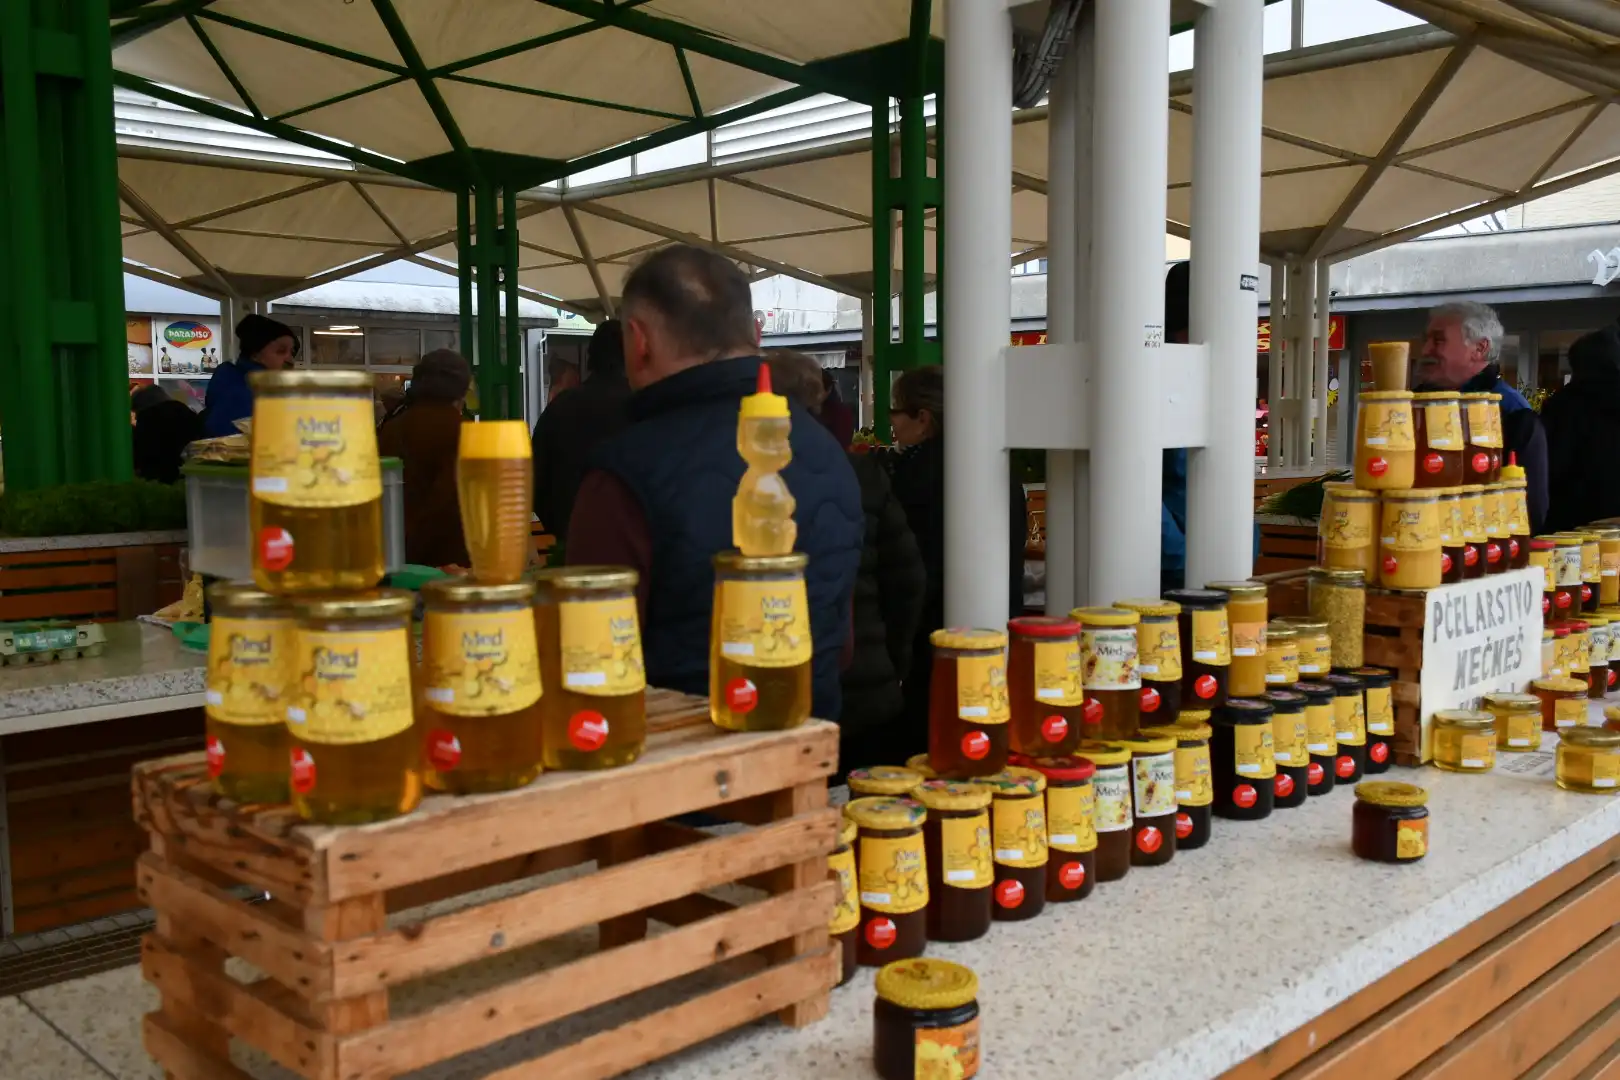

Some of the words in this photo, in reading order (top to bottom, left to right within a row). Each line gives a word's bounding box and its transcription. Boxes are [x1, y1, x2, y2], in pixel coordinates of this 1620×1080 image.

[168, 329, 209, 340] PARADISO
[298, 415, 341, 434] Med
[1433, 580, 1533, 643] PČELARSTVO
[463, 627, 502, 646] Med
[317, 648, 358, 667] Med
[1097, 645, 1123, 656] Med
[1453, 626, 1525, 691] KEČKEŠ
[1096, 785, 1121, 797] Med
